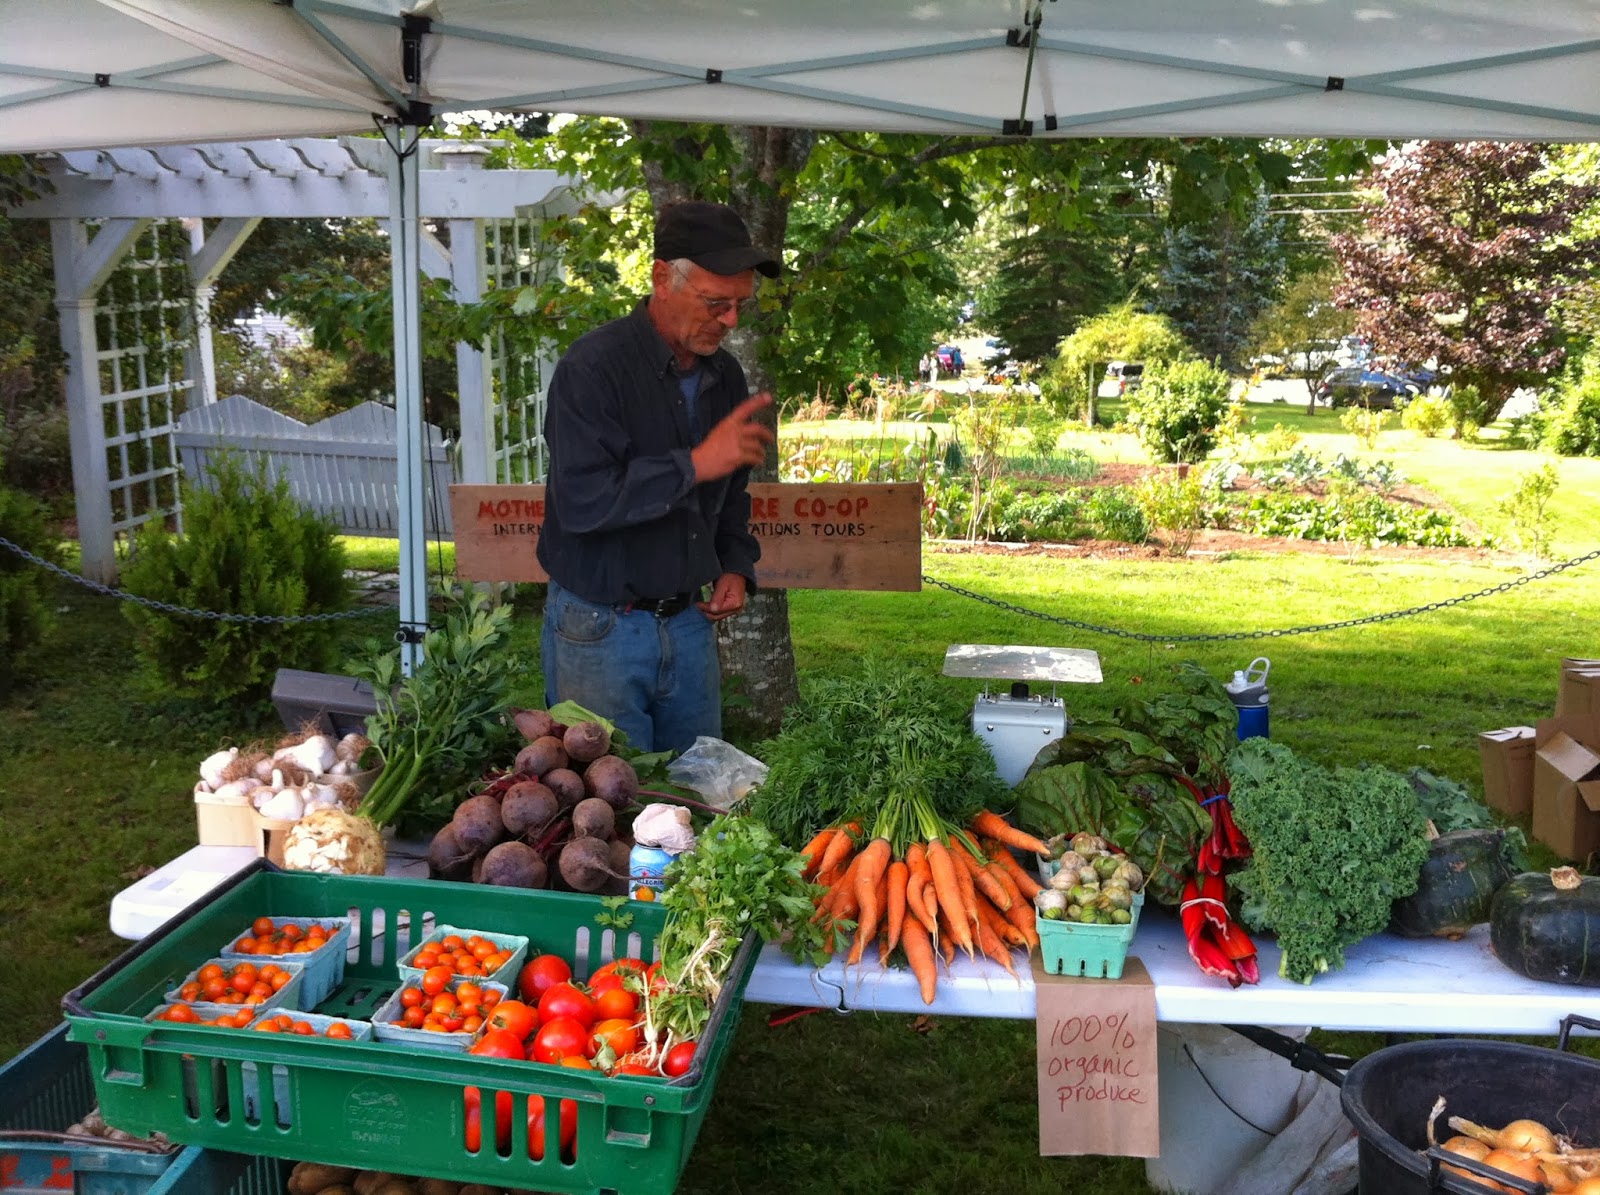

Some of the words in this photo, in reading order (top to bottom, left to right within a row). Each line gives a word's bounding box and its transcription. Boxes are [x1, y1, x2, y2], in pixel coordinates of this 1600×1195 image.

[478, 499, 545, 518] MOTHE
[752, 497, 779, 519] RE
[794, 496, 869, 518] CO-OP
[811, 522, 866, 537] TOURS
[1050, 1012, 1135, 1049] 100%
[1048, 1051, 1139, 1088] organic
[1057, 1078, 1147, 1112] produce
